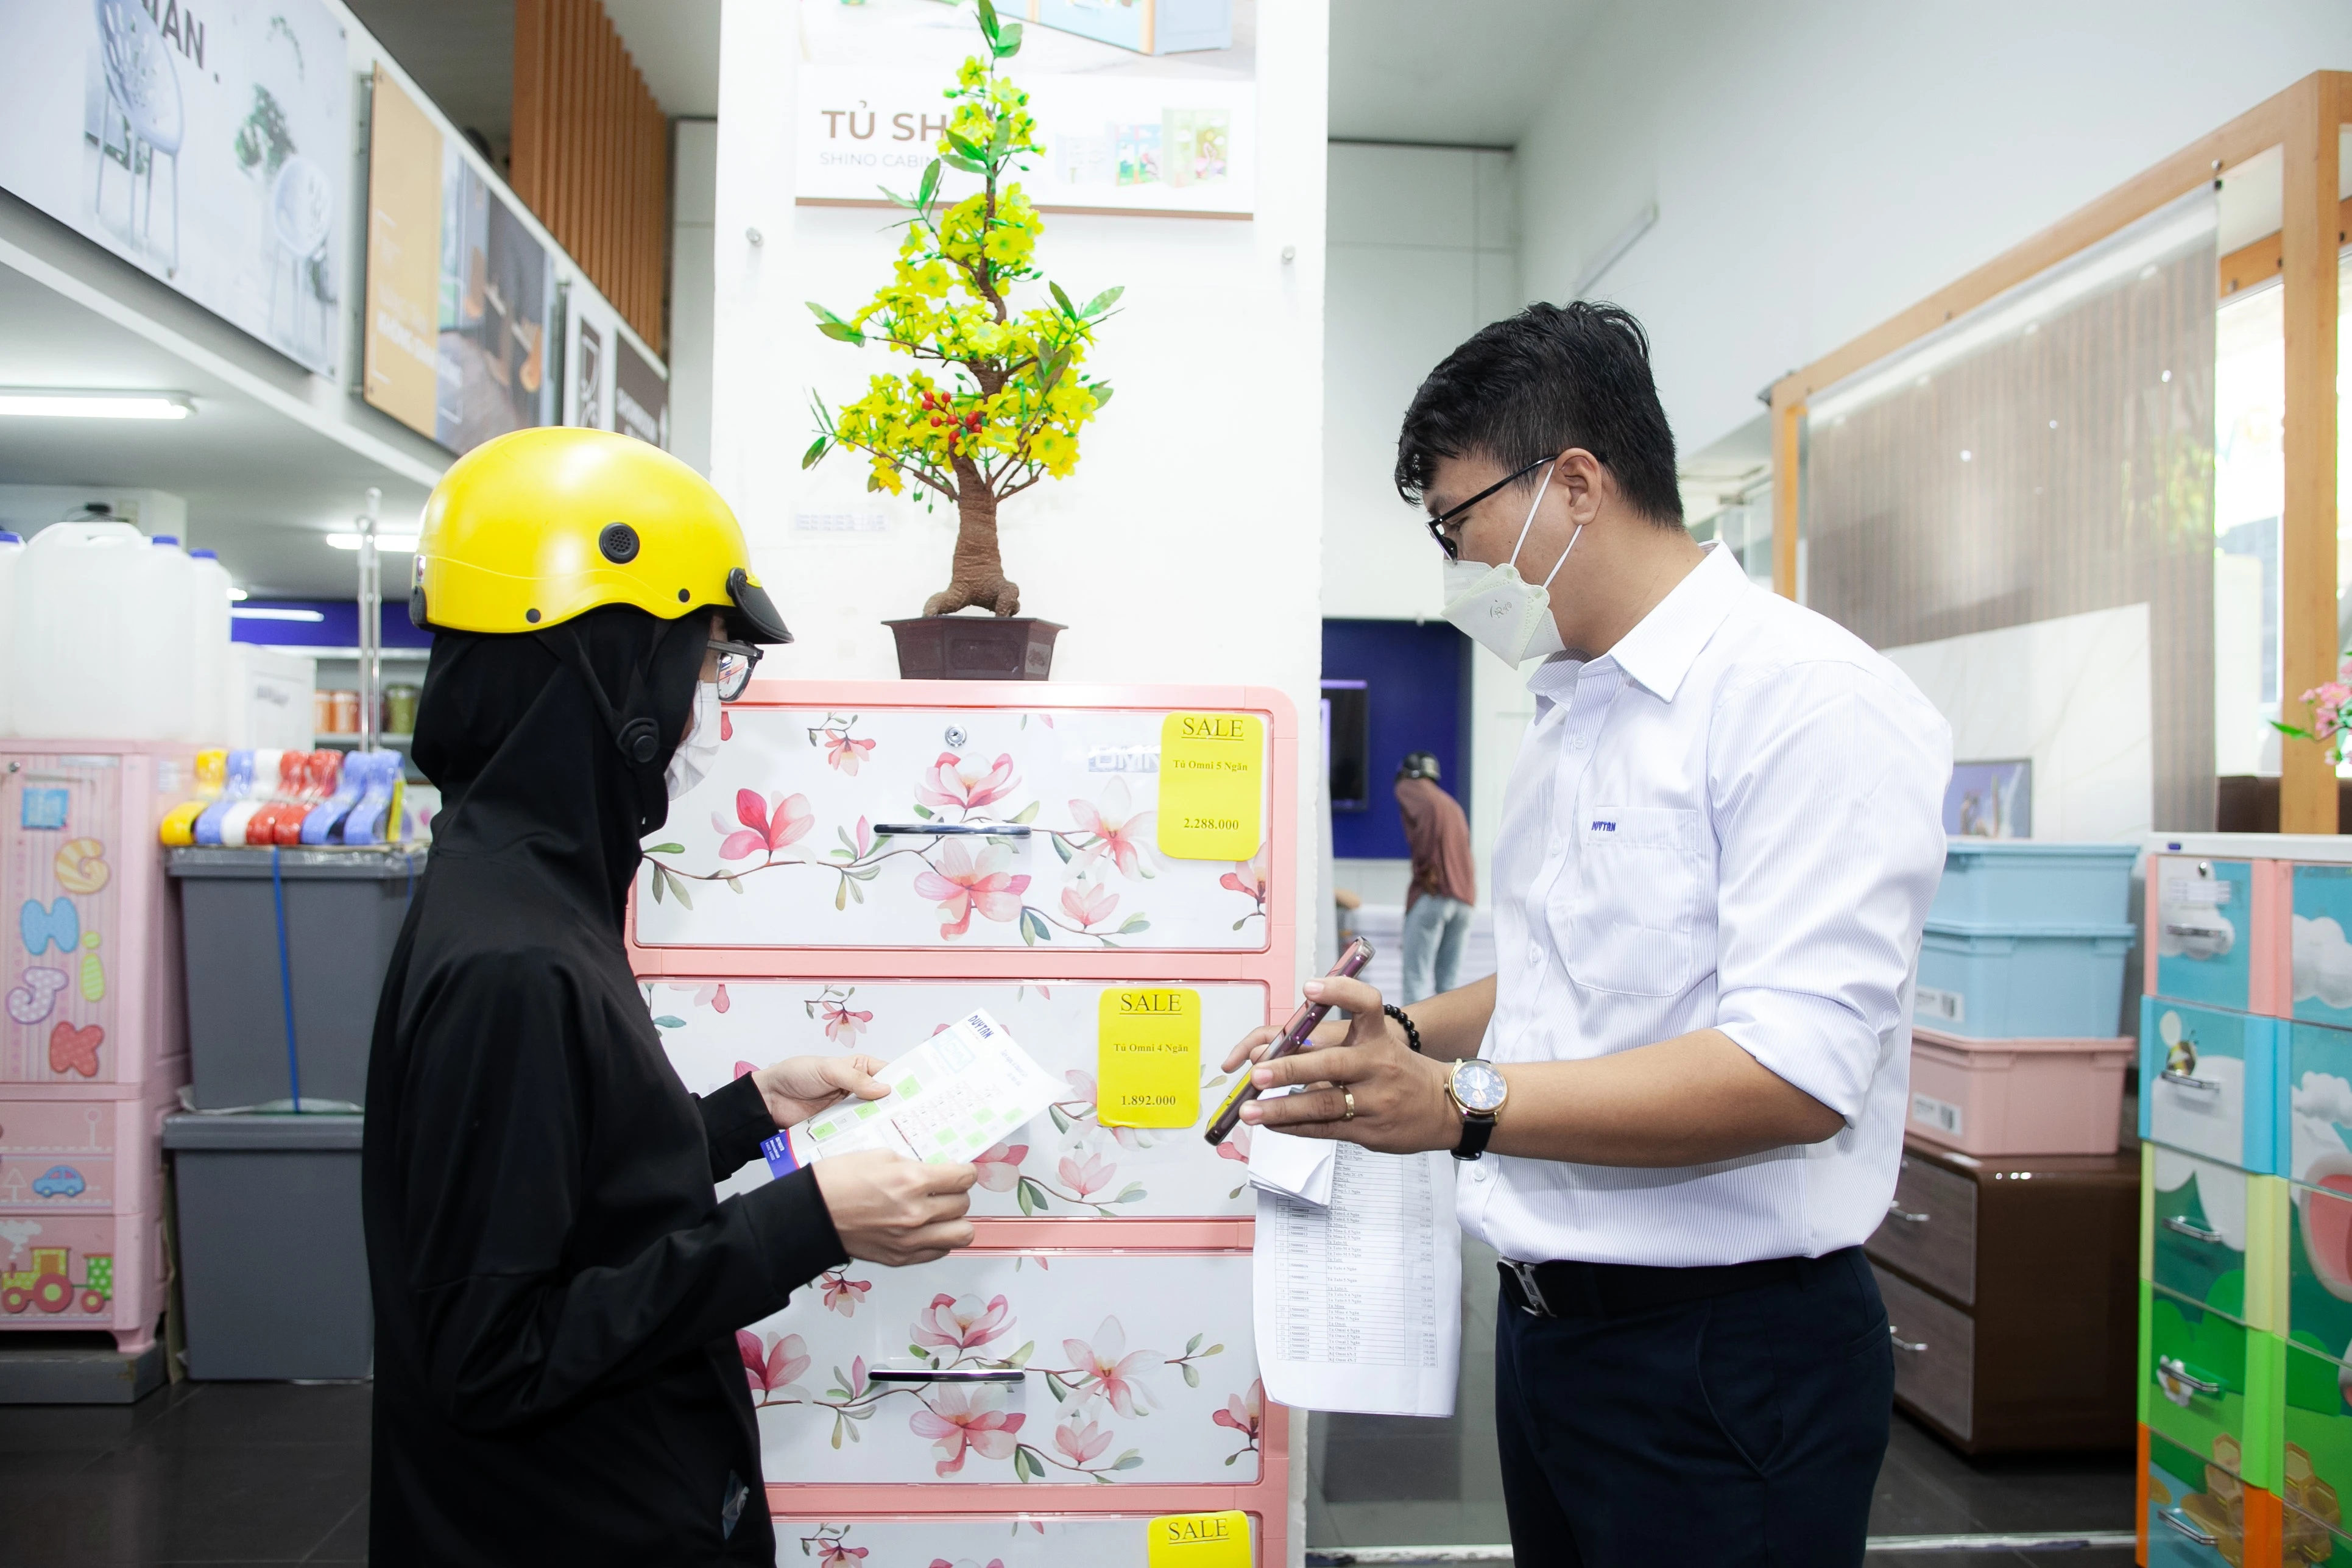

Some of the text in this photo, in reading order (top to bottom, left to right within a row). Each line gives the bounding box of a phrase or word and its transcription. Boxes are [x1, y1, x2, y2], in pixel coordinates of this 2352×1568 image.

[821, 100, 946, 141] TỦ SH
[820, 152, 877, 166] SHINO
[1182, 718, 1243, 737] SALE
[1173, 759, 1248, 772] Tủ Omni 5 Ngăn
[1184, 818, 1239, 830] 2.288.000
[54, 836, 111, 895] G
[20, 896, 80, 956] H
[6, 966, 69, 1025] J
[1121, 994, 1182, 1012] SALE
[968, 1014, 994, 1039] DUYTAN
[49, 1020, 105, 1078] K
[1114, 1043, 1188, 1054] Tủ Omni 4 Ngăn
[1122, 1095, 1176, 1106] 1.892.000
[1168, 1518, 1229, 1541] SALE
